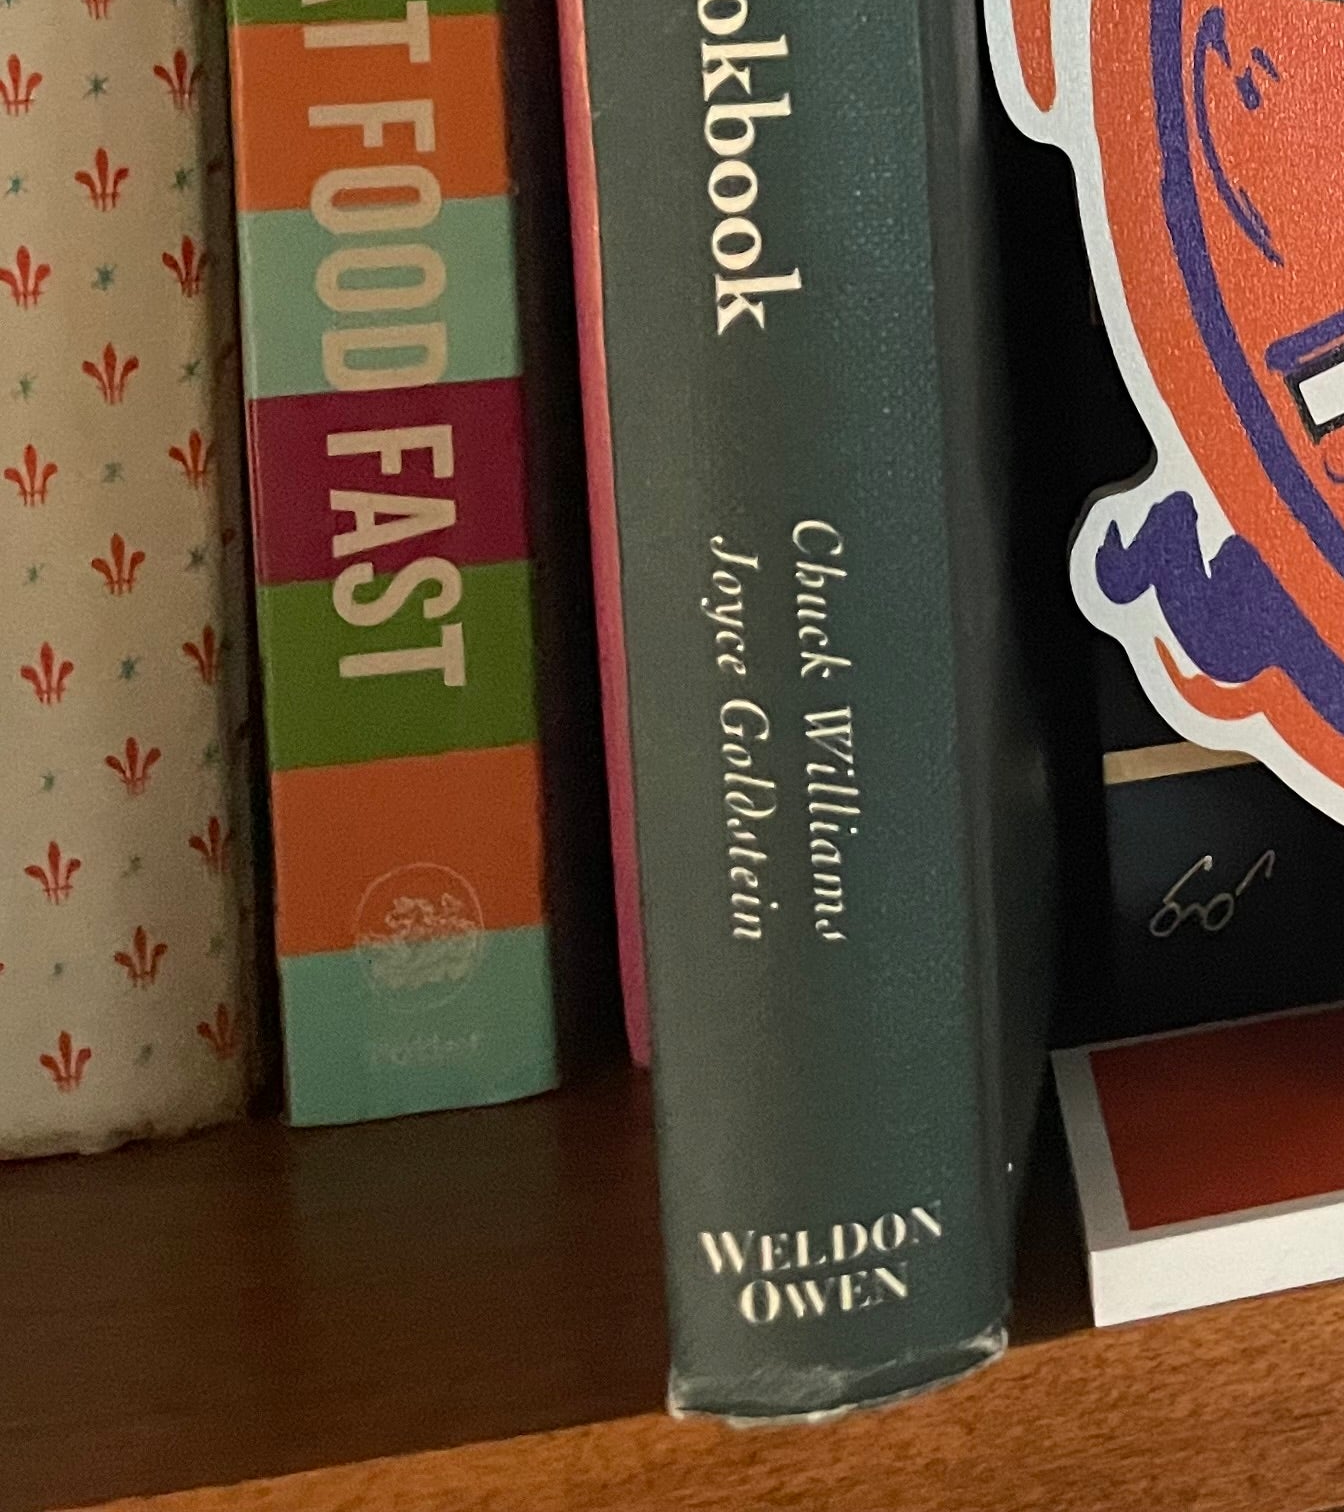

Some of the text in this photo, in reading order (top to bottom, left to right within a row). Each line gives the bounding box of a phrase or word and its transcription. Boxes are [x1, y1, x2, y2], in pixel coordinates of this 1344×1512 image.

[307, 97, 448, 393] FOOD
[325, 423, 467, 688] FAST
[700, 534, 778, 941] Joyce Goldstein
[791, 519, 862, 941] Chuck Williams
[697, 1199, 943, 1275] WELDON
[738, 1261, 909, 1324] OWEN
